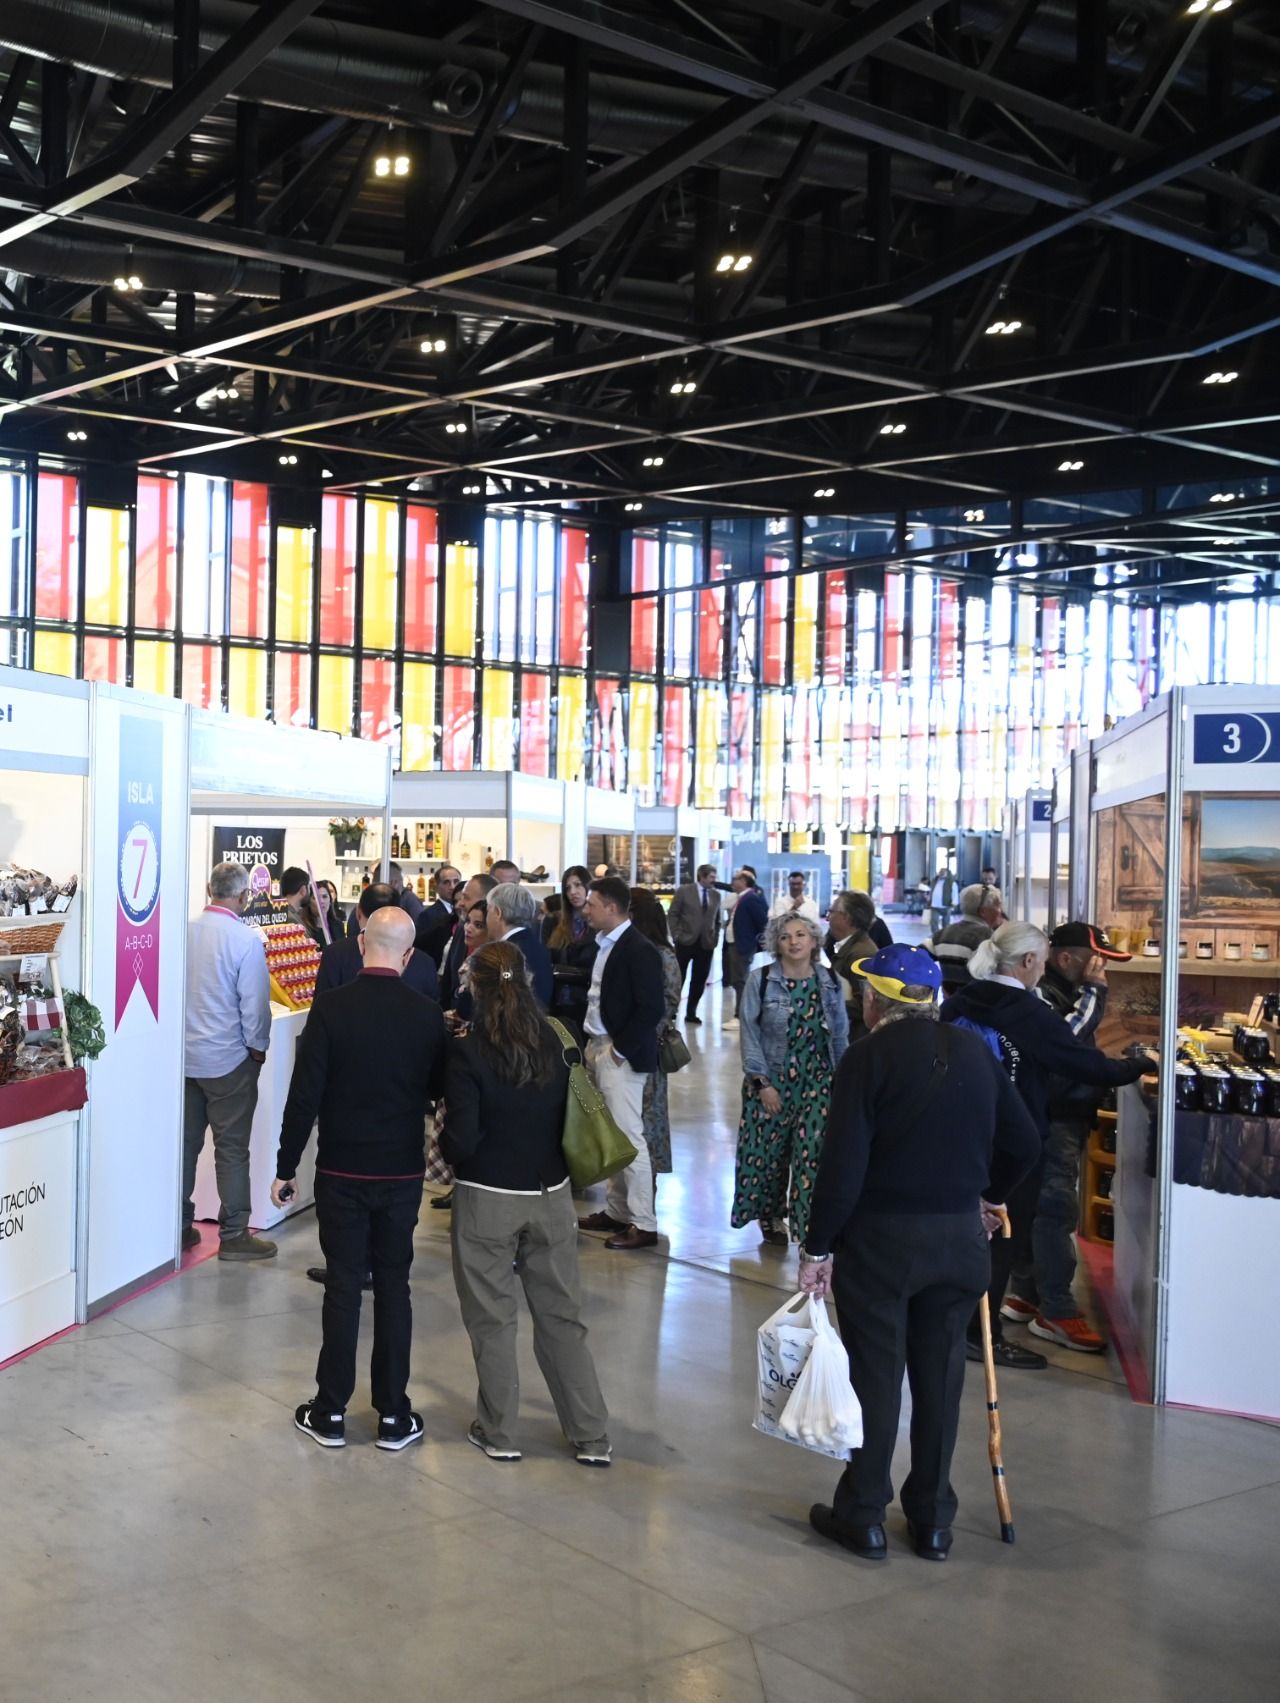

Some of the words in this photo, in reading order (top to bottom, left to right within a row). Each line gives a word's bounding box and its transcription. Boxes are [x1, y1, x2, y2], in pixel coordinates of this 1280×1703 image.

[1222, 723, 1241, 754] 3
[128, 781, 154, 804] ISLA
[1043, 804, 1051, 818] 2
[236, 835, 263, 849] LOS
[222, 851, 278, 865] PRIETOS
[132, 839, 148, 899] 7
[125, 934, 153, 950] A-B-C-D
